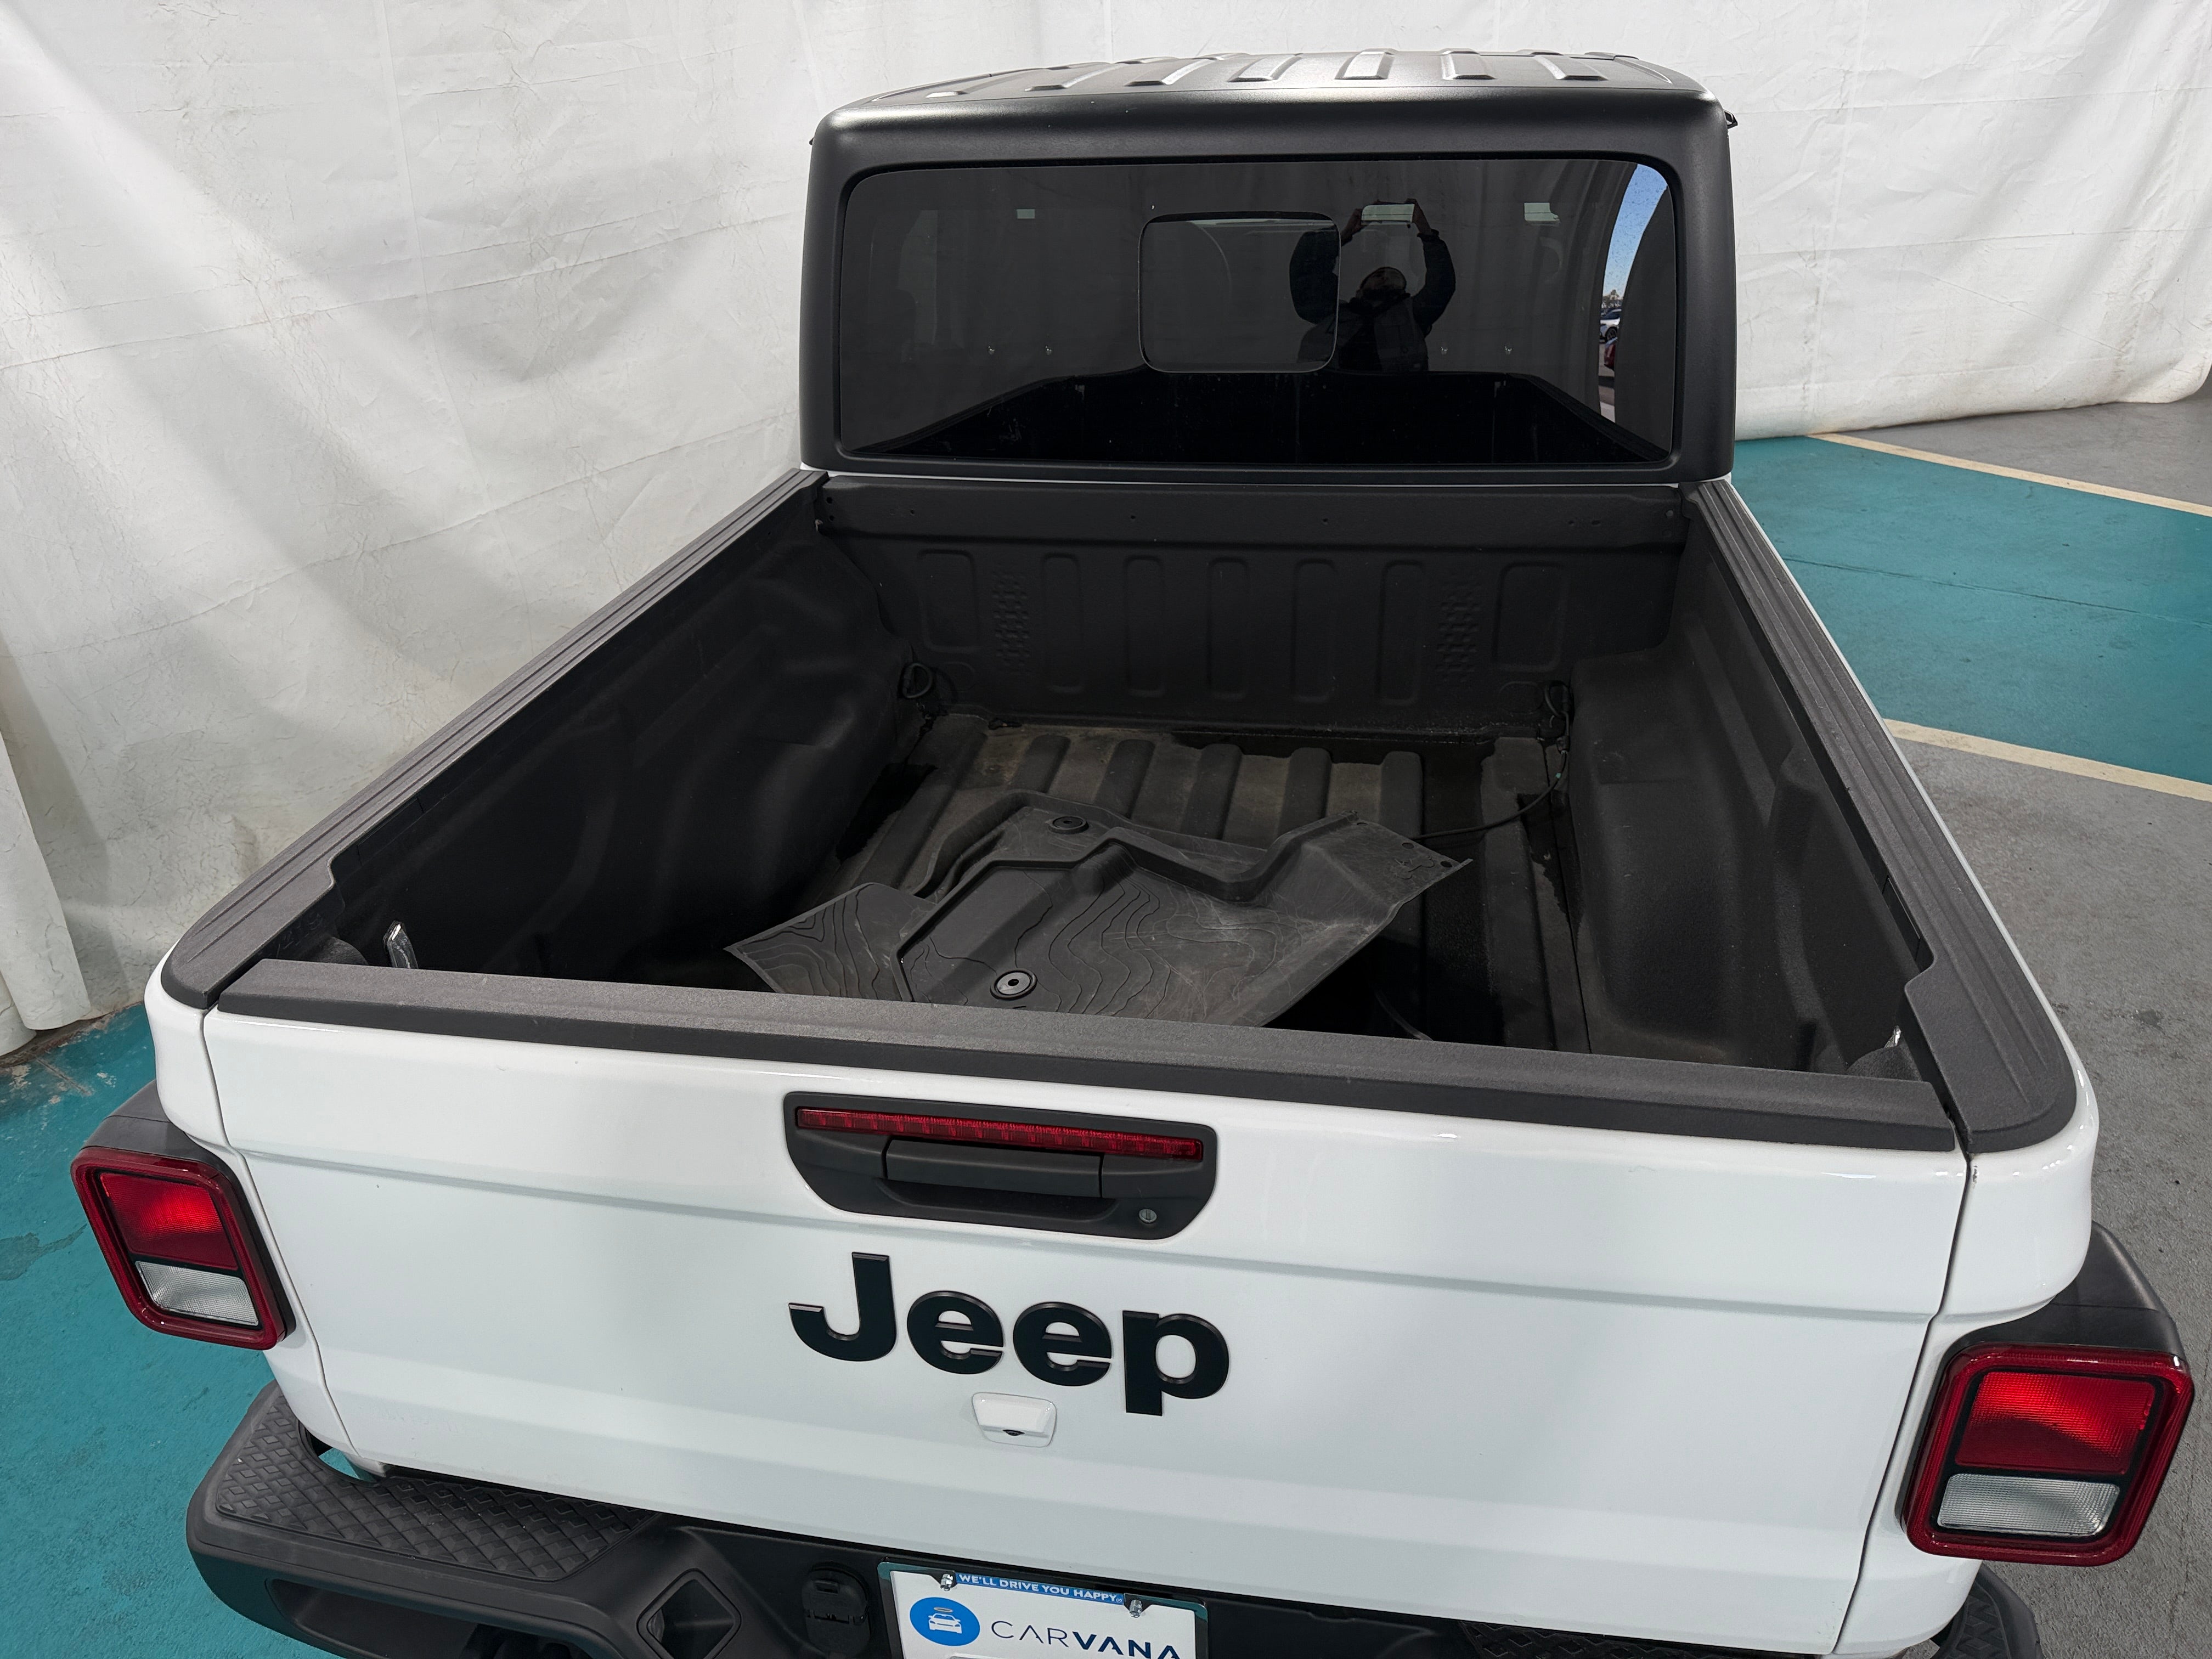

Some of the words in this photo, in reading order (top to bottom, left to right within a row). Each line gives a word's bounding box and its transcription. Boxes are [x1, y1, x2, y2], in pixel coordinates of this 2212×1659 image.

[788, 1252, 1229, 1417] Jeep
[958, 1574, 997, 1586] WE'LL
[999, 1579, 1039, 1592] DRIVE
[1041, 1585, 1070, 1595] YOU
[991, 1621, 1181, 1659] CARVANA
